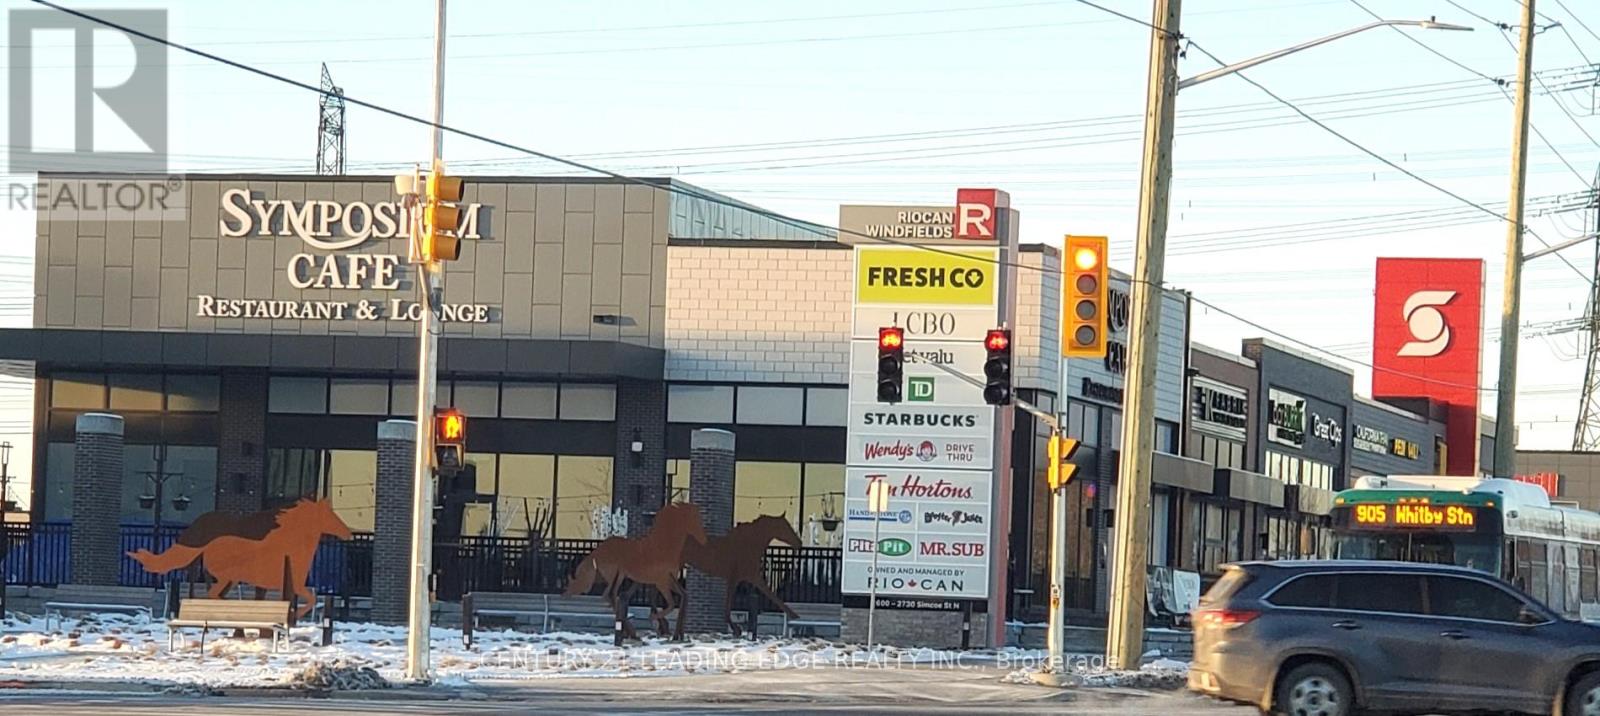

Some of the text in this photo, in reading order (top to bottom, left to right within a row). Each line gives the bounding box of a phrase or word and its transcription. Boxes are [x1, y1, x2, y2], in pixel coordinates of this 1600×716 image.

[220, 189, 481, 249] SYMPOSIM
[898, 211, 952, 225] RIOCAN
[958, 203, 992, 236] R
[865, 224, 952, 238] WINDFIELDS
[288, 254, 399, 289] CAFE
[198, 295, 488, 323] RESTAURANT & LONGE
[911, 381, 932, 396] TD
[864, 413, 976, 427] STARBUCKS
[865, 440, 914, 460] Wendy's
[946, 444, 974, 452] DRIVE
[948, 453, 973, 461] THRU
[900, 475, 972, 499] Hortons
[1357, 506, 1474, 526] 905 Whitby Stn
[920, 542, 984, 556] MR.SUB
[915, 568, 953, 576] MANAGED
[867, 577, 964, 591] RIO CAN
[916, 601, 942, 609] Simcoe
